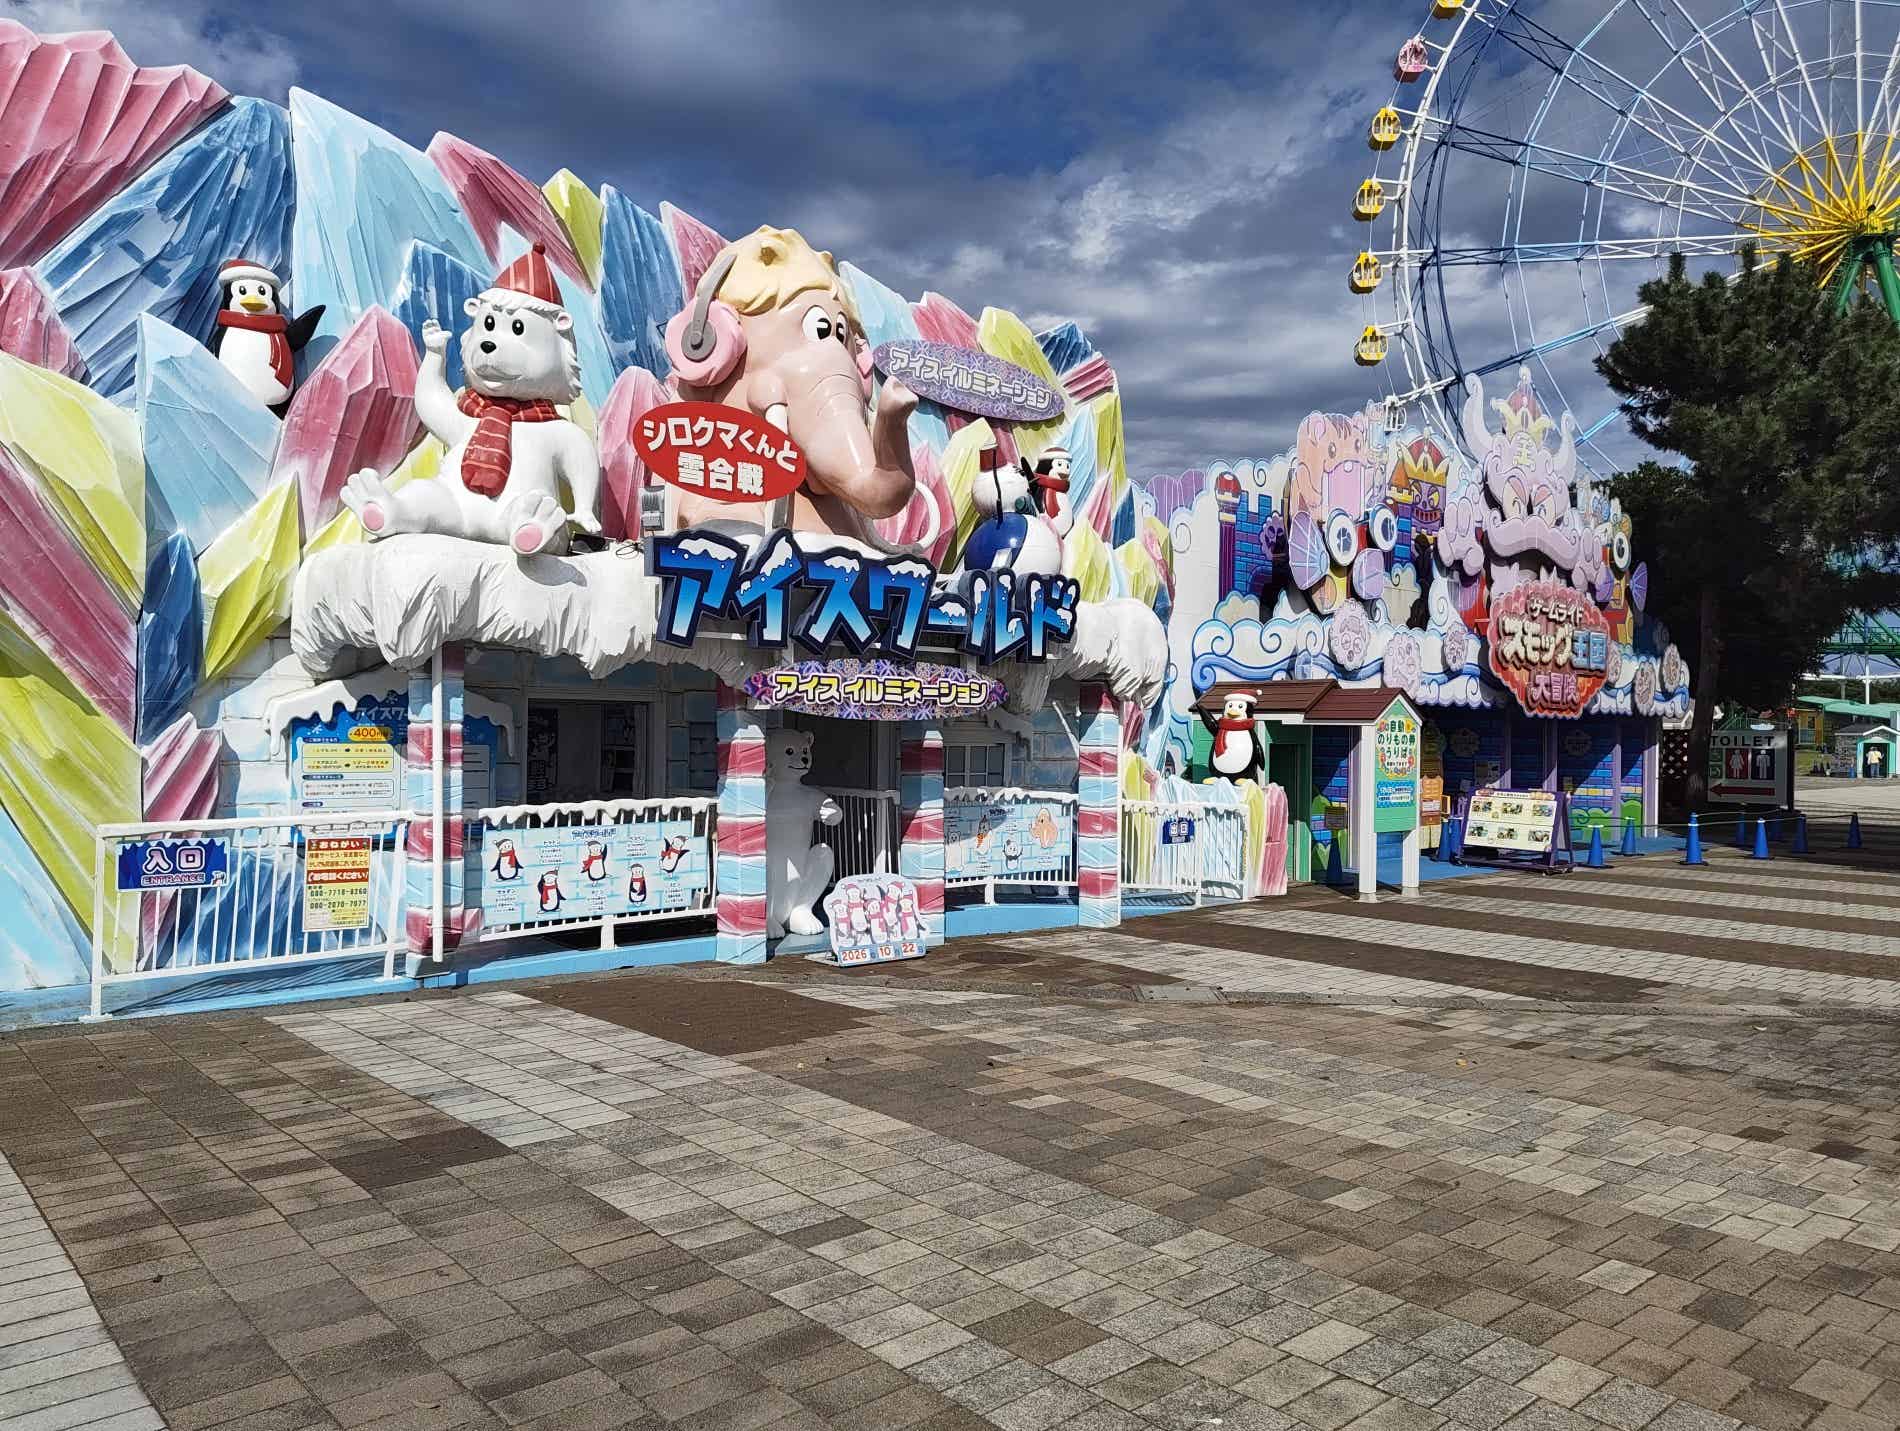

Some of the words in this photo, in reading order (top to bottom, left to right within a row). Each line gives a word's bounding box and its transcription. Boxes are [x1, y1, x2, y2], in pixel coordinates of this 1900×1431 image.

[643, 416, 798, 473] シロクマくんと
[677, 451, 764, 496] 雪合戦
[654, 529, 1079, 663] アイスワールド
[1529, 598, 1584, 627] ゲームライド
[1710, 735, 1775, 747] TOILET
[319, 840, 360, 849] おねがい
[143, 846, 205, 873] 入口
[141, 872, 206, 886] ENTRANCE
